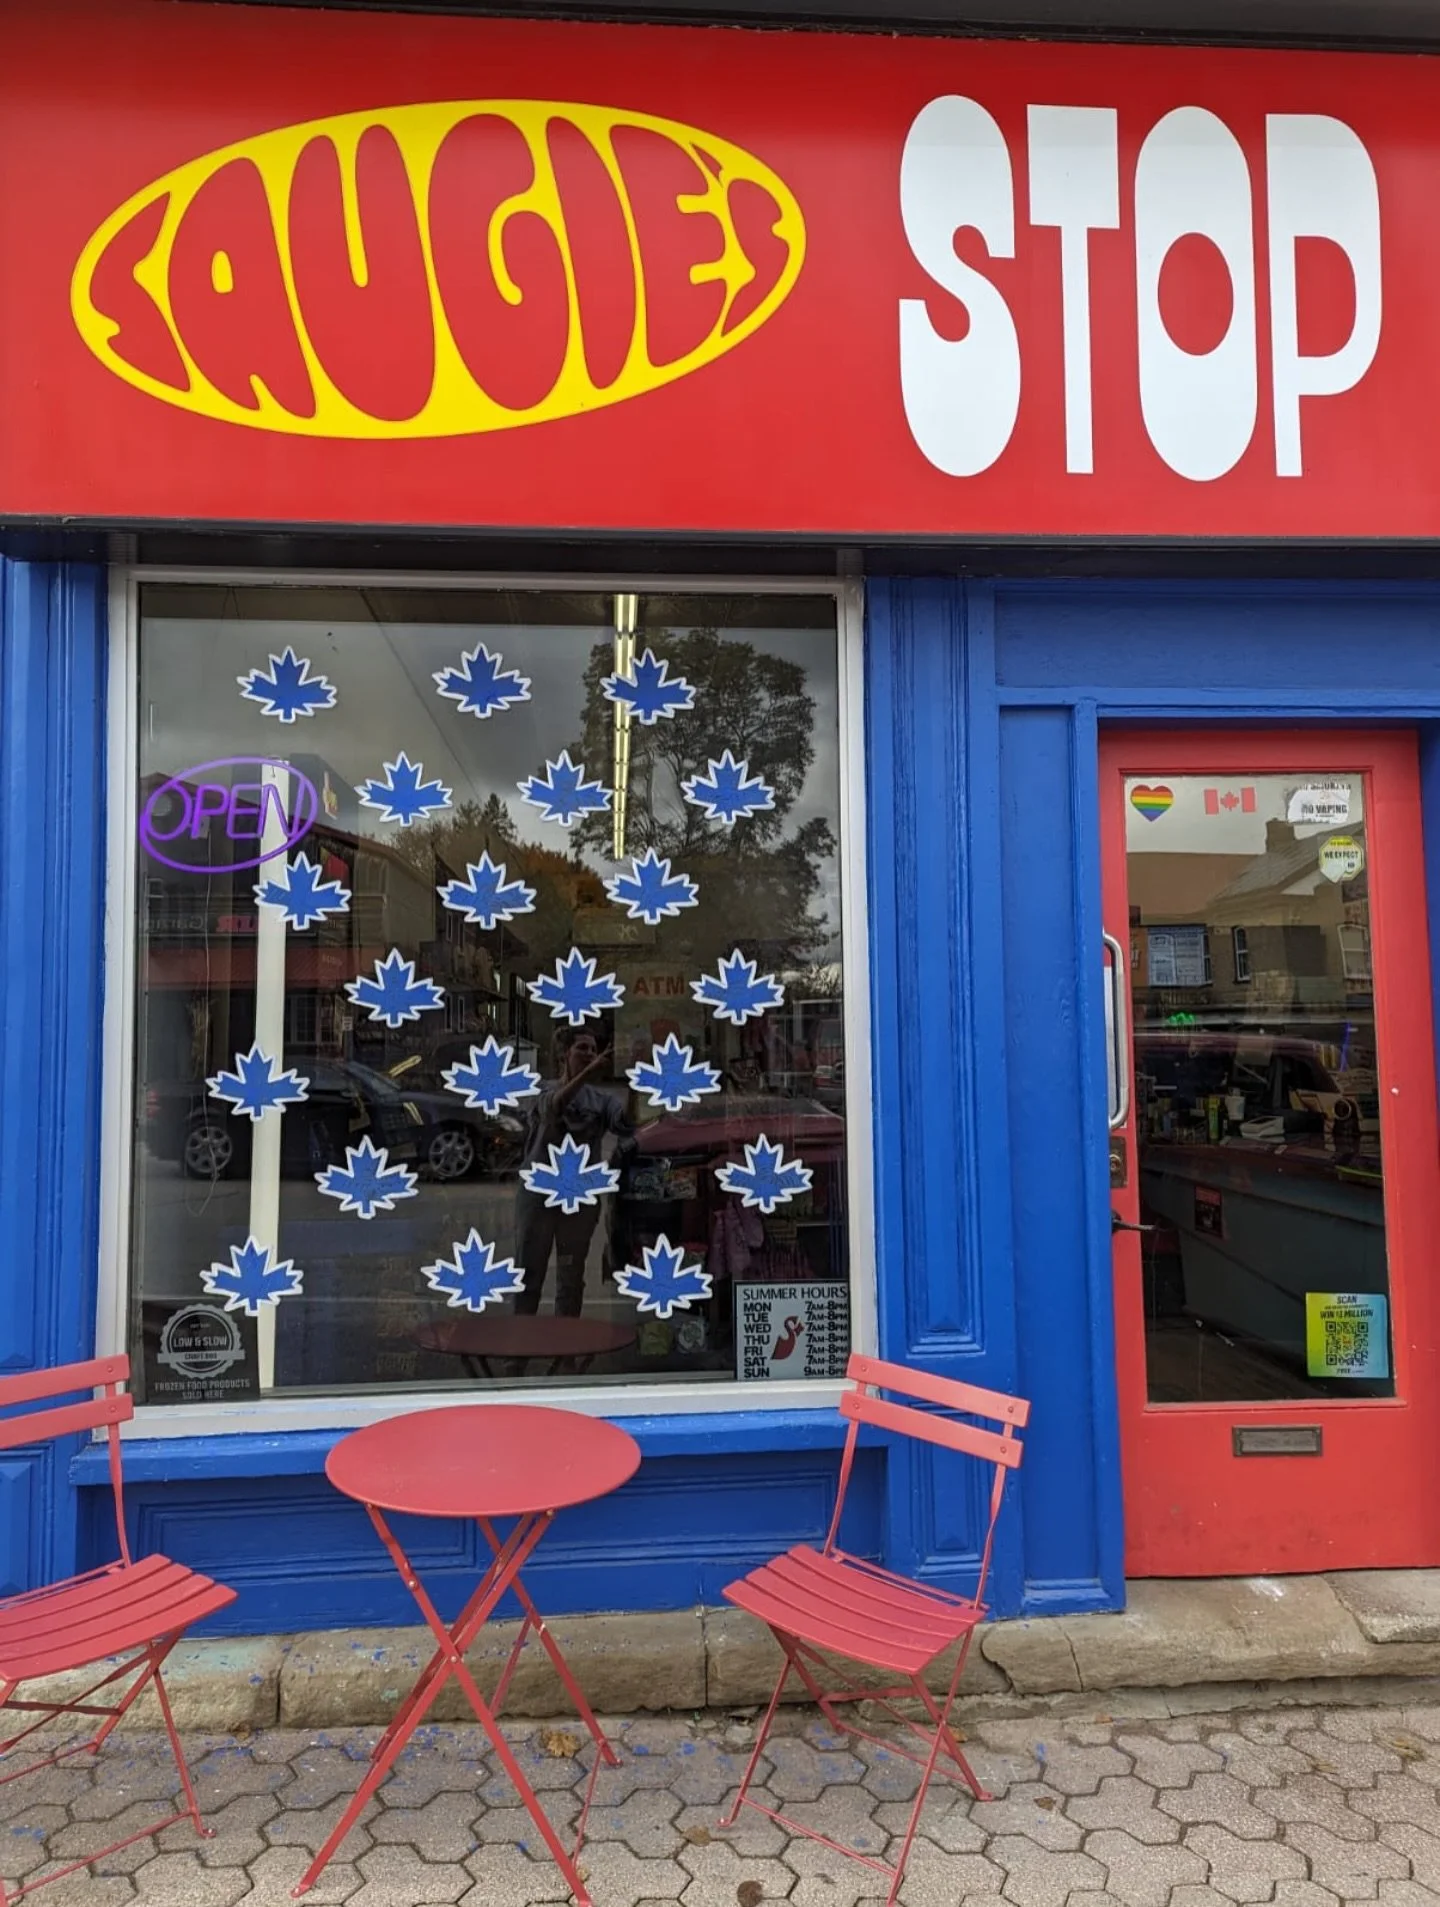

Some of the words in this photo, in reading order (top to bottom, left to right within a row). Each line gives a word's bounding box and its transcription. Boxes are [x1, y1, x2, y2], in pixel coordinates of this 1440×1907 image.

[899, 94, 1383, 482] STOP
[142, 780, 308, 841] OPEN
[1315, 803, 1348, 814] VAPING
[632, 973, 685, 995] ATM
[742, 1287, 797, 1300] SUMMER
[800, 1286, 848, 1299] HOURS
[1336, 1295, 1358, 1304] SCAN
[743, 1302, 771, 1312] MON
[743, 1312, 768, 1322] TUE
[1320, 1310, 1335, 1320] WIN
[1344, 1309, 1374, 1318] MILLION
[743, 1323, 771, 1333] WED
[173, 1336, 193, 1348] LOW
[202, 1335, 228, 1347] SLOW
[743, 1334, 770, 1345] THU
[743, 1346, 763, 1356] FRI
[743, 1357, 767, 1367] SAT
[743, 1367, 770, 1378] SUN
[208, 1378, 251, 1389] PRODUCTS
